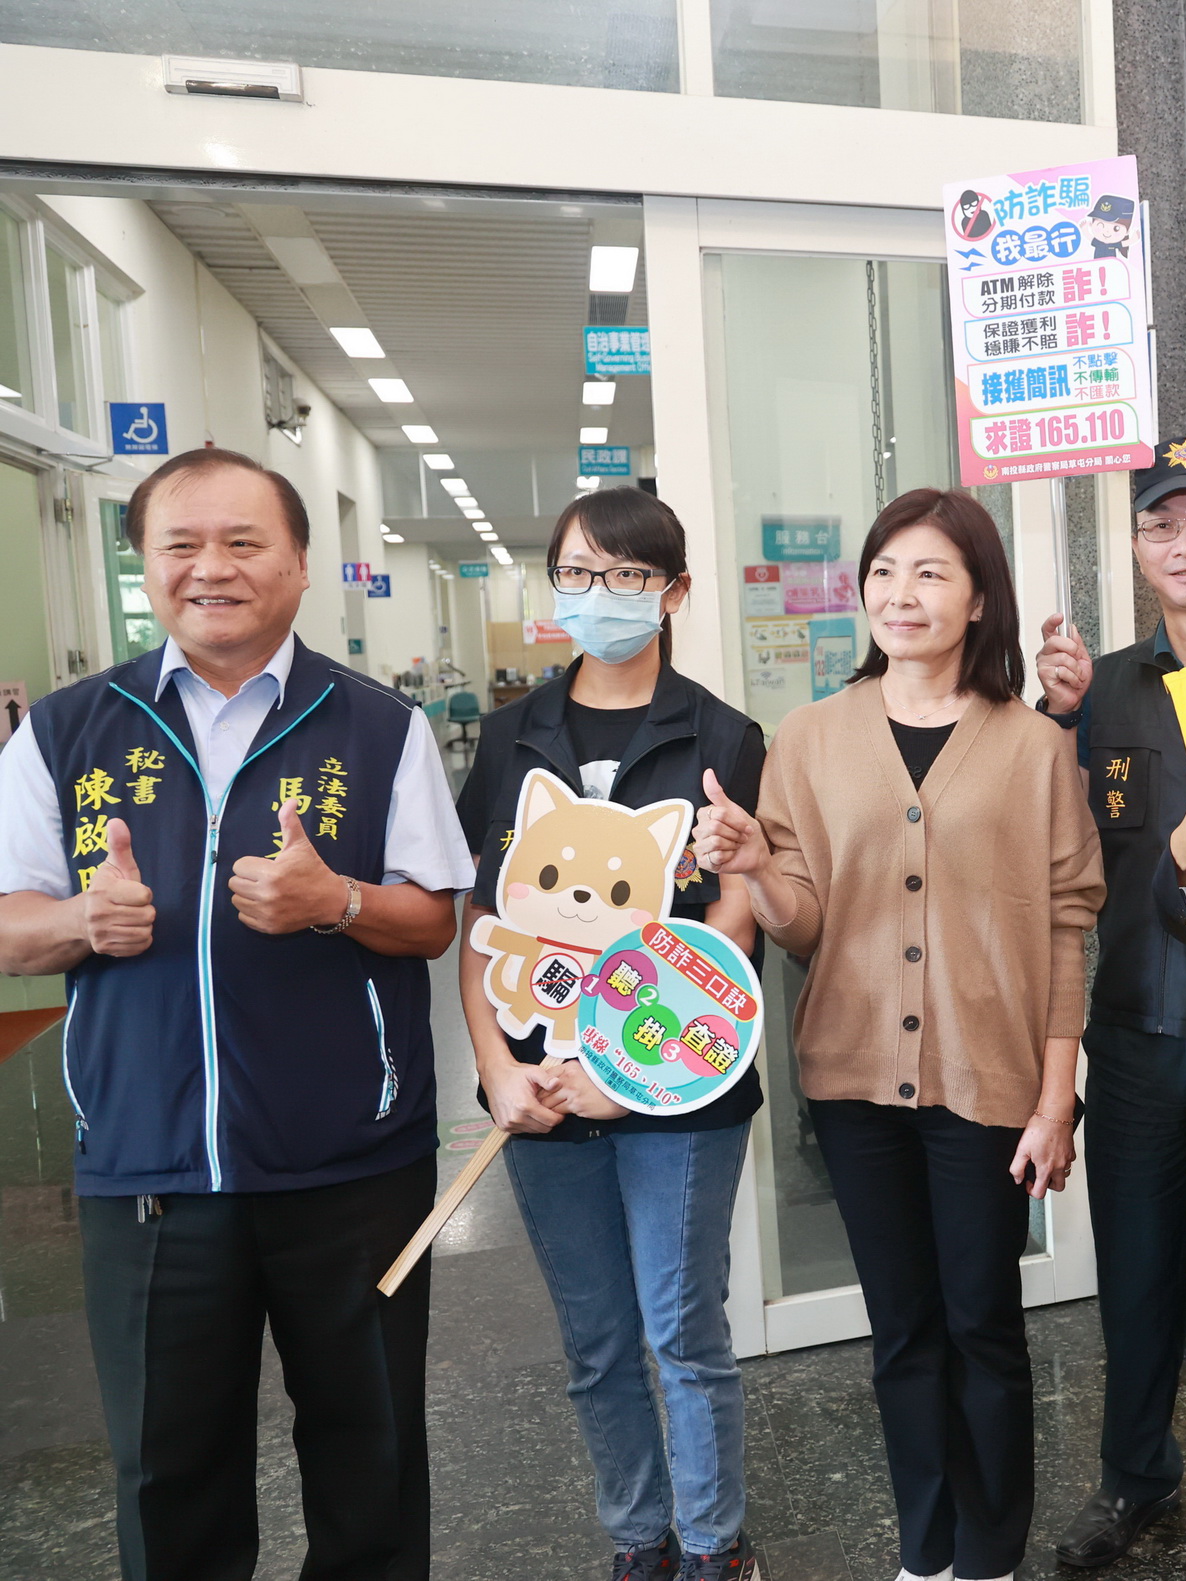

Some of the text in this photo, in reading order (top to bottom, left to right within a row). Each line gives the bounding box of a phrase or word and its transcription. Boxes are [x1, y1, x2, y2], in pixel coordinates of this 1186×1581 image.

[994, 176, 1090, 227] 防詐騙
[995, 227, 1078, 262] 我最行
[980, 272, 1055, 296] ATM 解除
[981, 290, 1056, 314] 分期付款
[983, 315, 1057, 339] 保證獲利
[984, 333, 1058, 357] 穩賺不賠
[1072, 351, 1119, 369] 不點擊
[981, 364, 1071, 406] 接獲簡訊
[1073, 367, 1120, 385] 不傳輸
[1074, 383, 1121, 400] 不匯款
[985, 408, 1125, 455] 求證 165.110
[1001, 453, 1131, 476] 南投縣政府警察局草屯分局 關心您
[775, 530, 829, 545] 服務台
[124, 747, 165, 805] 秘書
[1105, 757, 1131, 819] 刑警
[315, 757, 348, 841] 立法委員
[538, 958, 577, 1004] 騙
[584, 976, 599, 993] 1
[606, 960, 644, 996] 聽
[648, 928, 746, 1016] 防詐三口訣
[640, 988, 657, 1006] 2
[582, 1026, 610, 1055] 專線
[632, 1016, 667, 1051] 掛
[680, 1019, 739, 1074] 查證
[663, 1043, 681, 1060] 3
